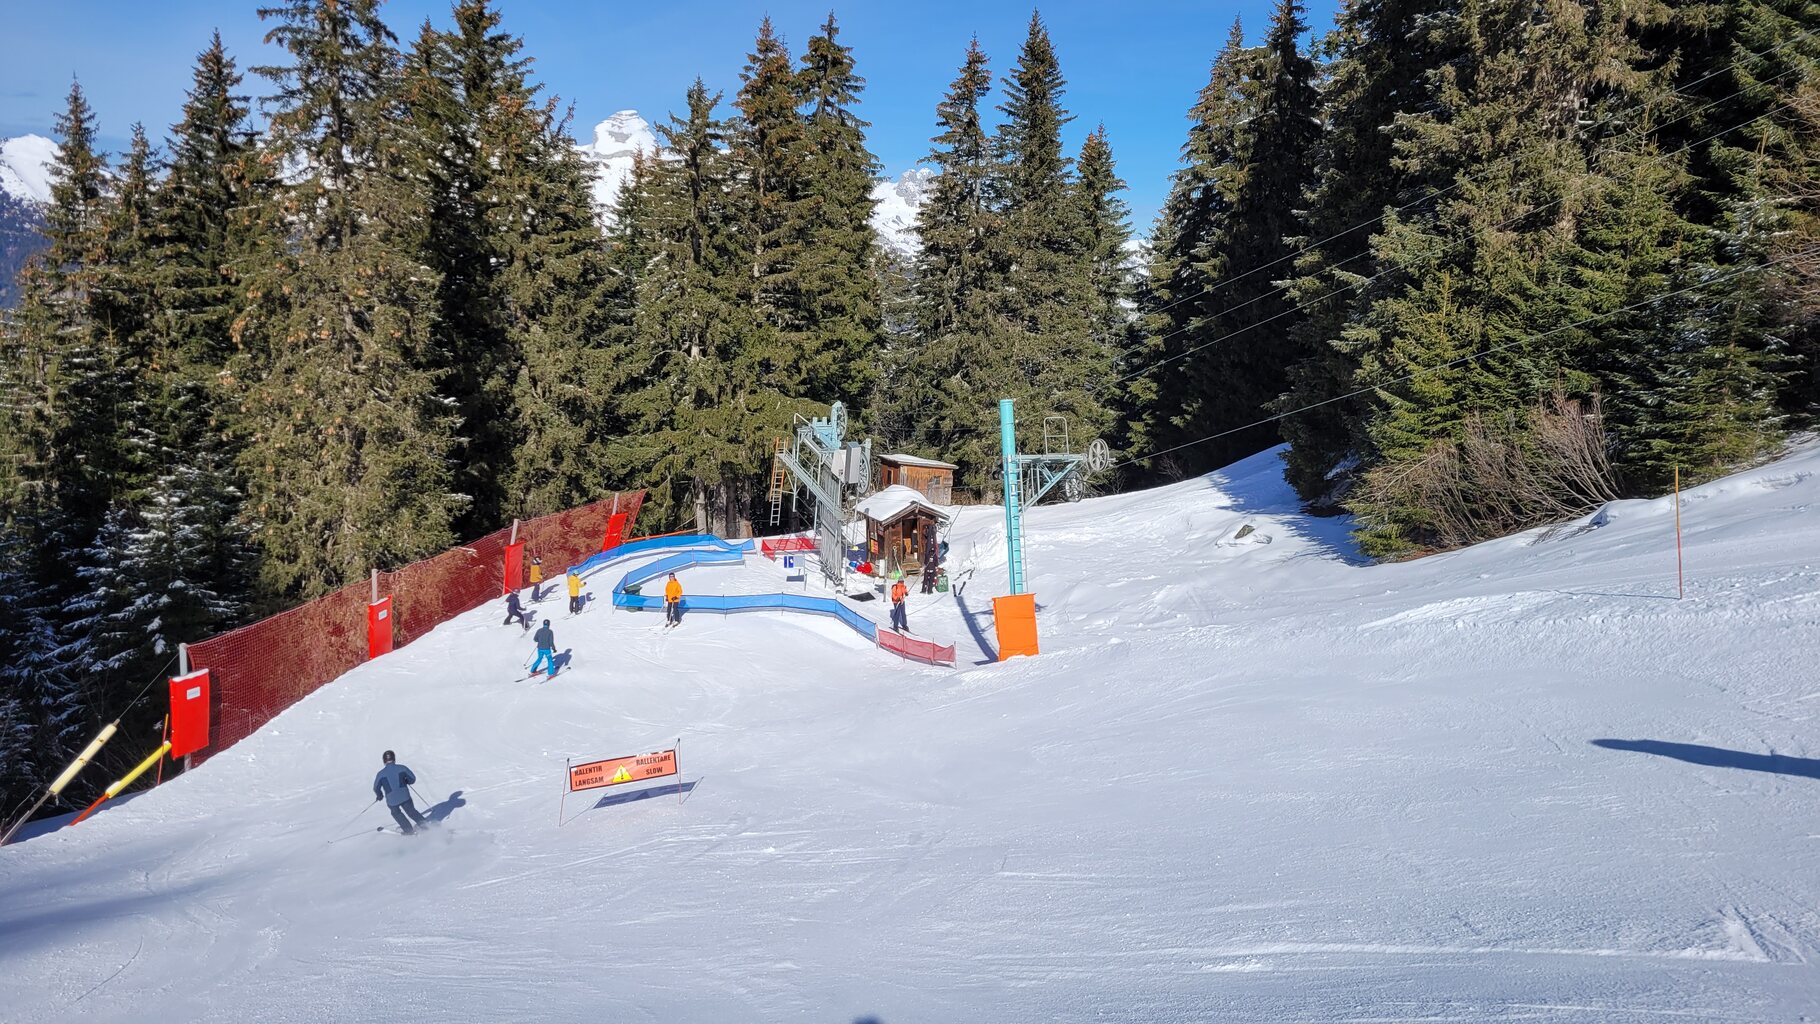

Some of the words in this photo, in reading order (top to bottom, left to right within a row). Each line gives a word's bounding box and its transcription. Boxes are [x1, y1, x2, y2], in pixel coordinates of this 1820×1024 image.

[636, 754, 671, 766] RALLENTARE
[574, 765, 603, 777] RALENTIR
[645, 766, 663, 776] SLOW
[575, 776, 604, 787] LANGSAM
